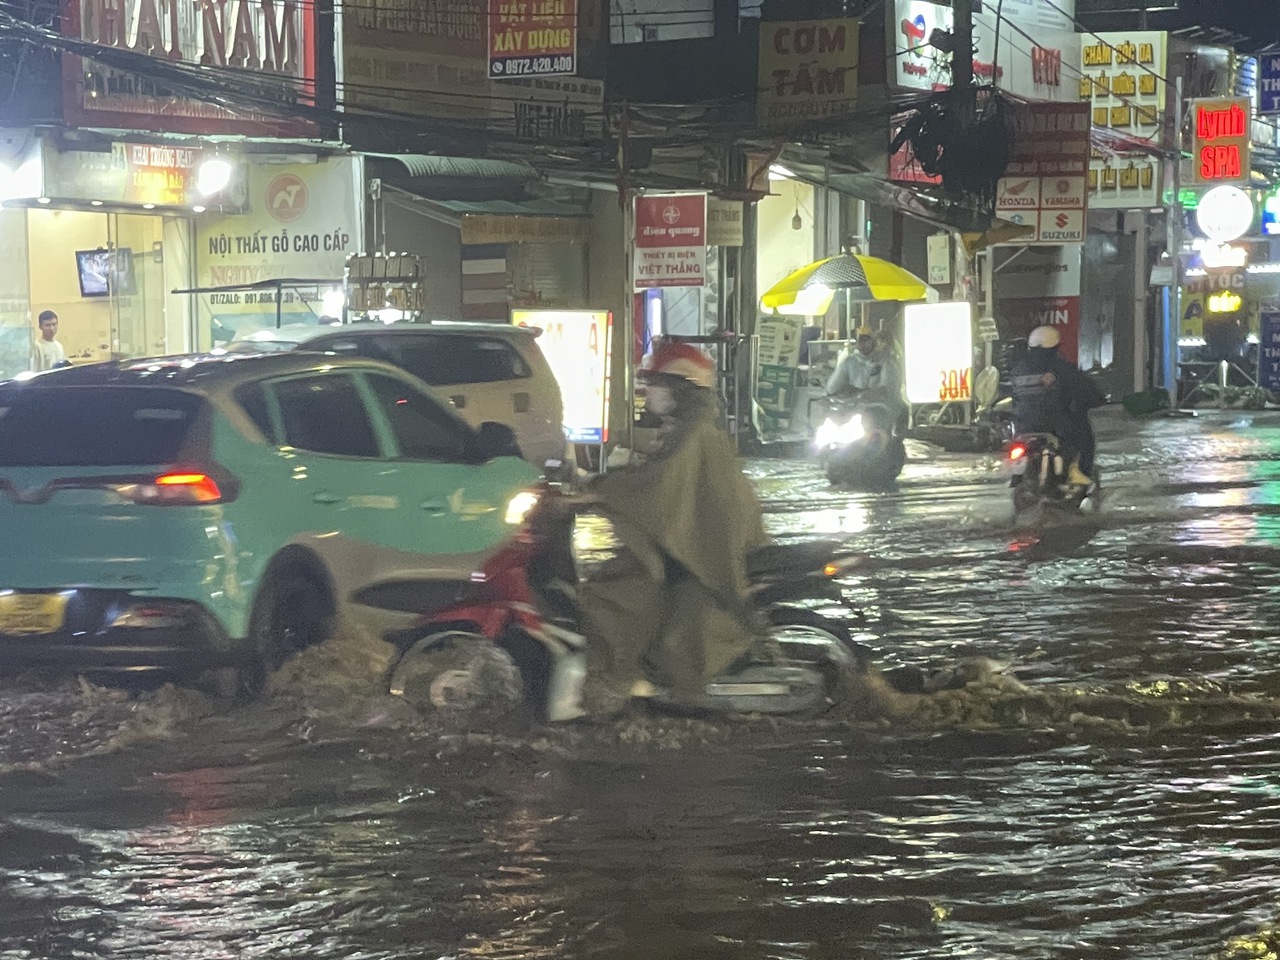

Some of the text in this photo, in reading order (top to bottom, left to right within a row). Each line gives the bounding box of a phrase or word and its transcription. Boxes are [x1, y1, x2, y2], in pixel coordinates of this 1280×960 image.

[494, 28, 571, 53] XÂY DỰNG
[773, 26, 846, 55] CƠM
[506, 56, 572, 74] 0972.420.400
[1197, 104, 1246, 140] Lynh
[1200, 146, 1241, 179] SPA
[999, 198, 1035, 206] HONDA
[209, 227, 350, 258] NỘI THẤT GỖ CAO CẤP
[1042, 231, 1080, 239] SUZUKI
[639, 260, 700, 277] VIỆT THẮNG
